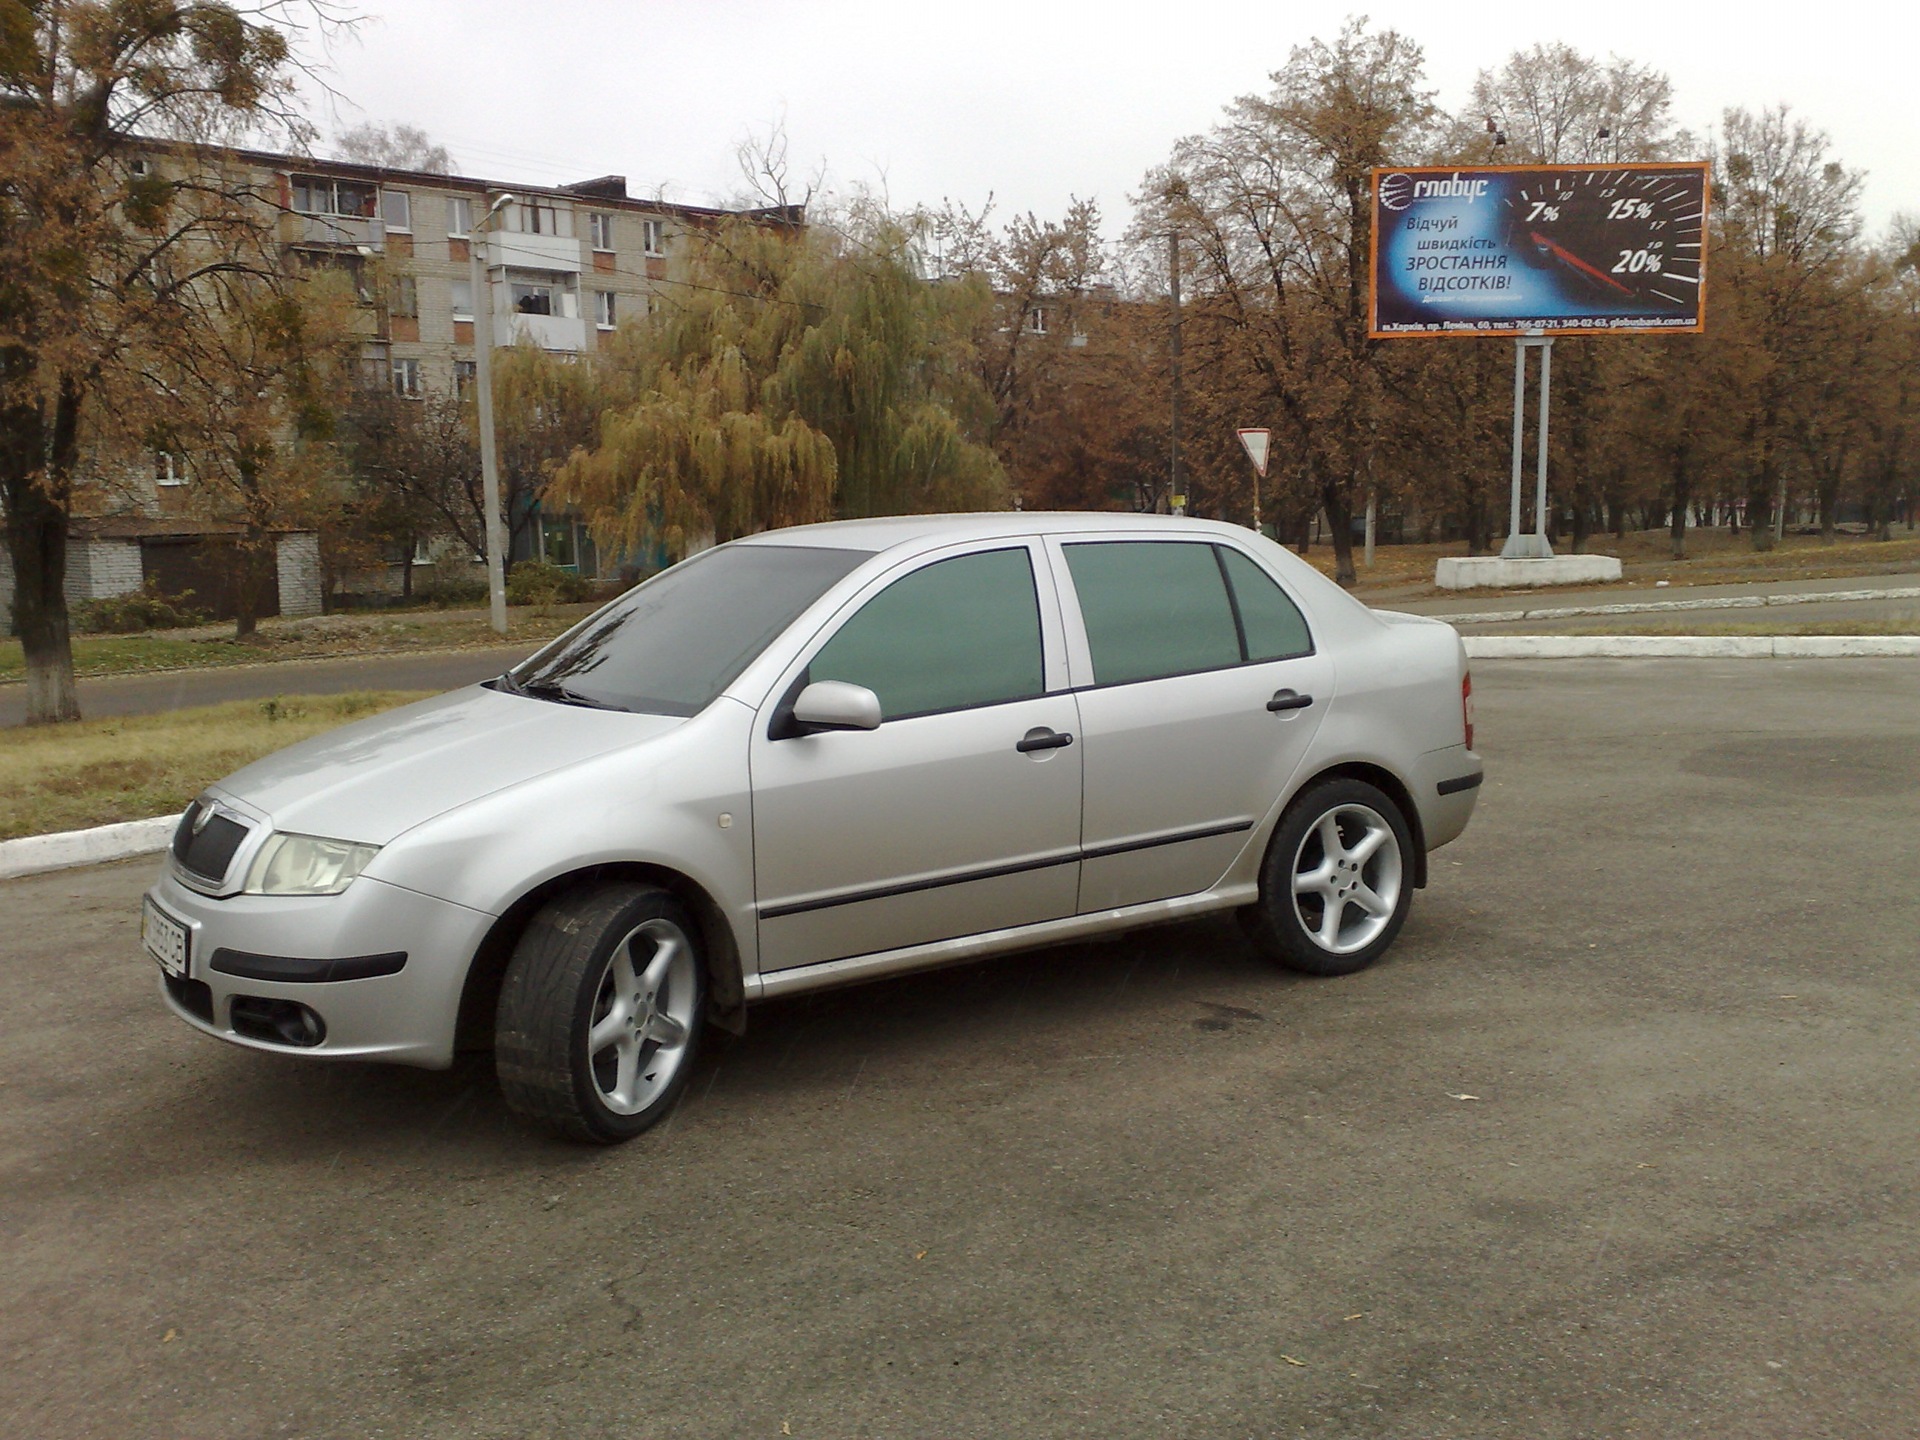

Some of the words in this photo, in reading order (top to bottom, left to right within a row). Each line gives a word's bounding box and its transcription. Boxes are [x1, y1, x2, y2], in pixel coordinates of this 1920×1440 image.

[1557, 190, 1574, 201] 10
[1599, 188, 1617, 198] 13
[1526, 202, 1560, 222] 7%
[1606, 198, 1656, 220] 15%
[1406, 216, 1458, 232] Відчуй
[1649, 220, 1668, 230] 17
[1417, 236, 1496, 251] швидкість
[1405, 255, 1508, 271] ЗРОСТАННЯ
[1611, 249, 1664, 273] 20%
[1418, 275, 1512, 292] ВІДСОТКІВ!
